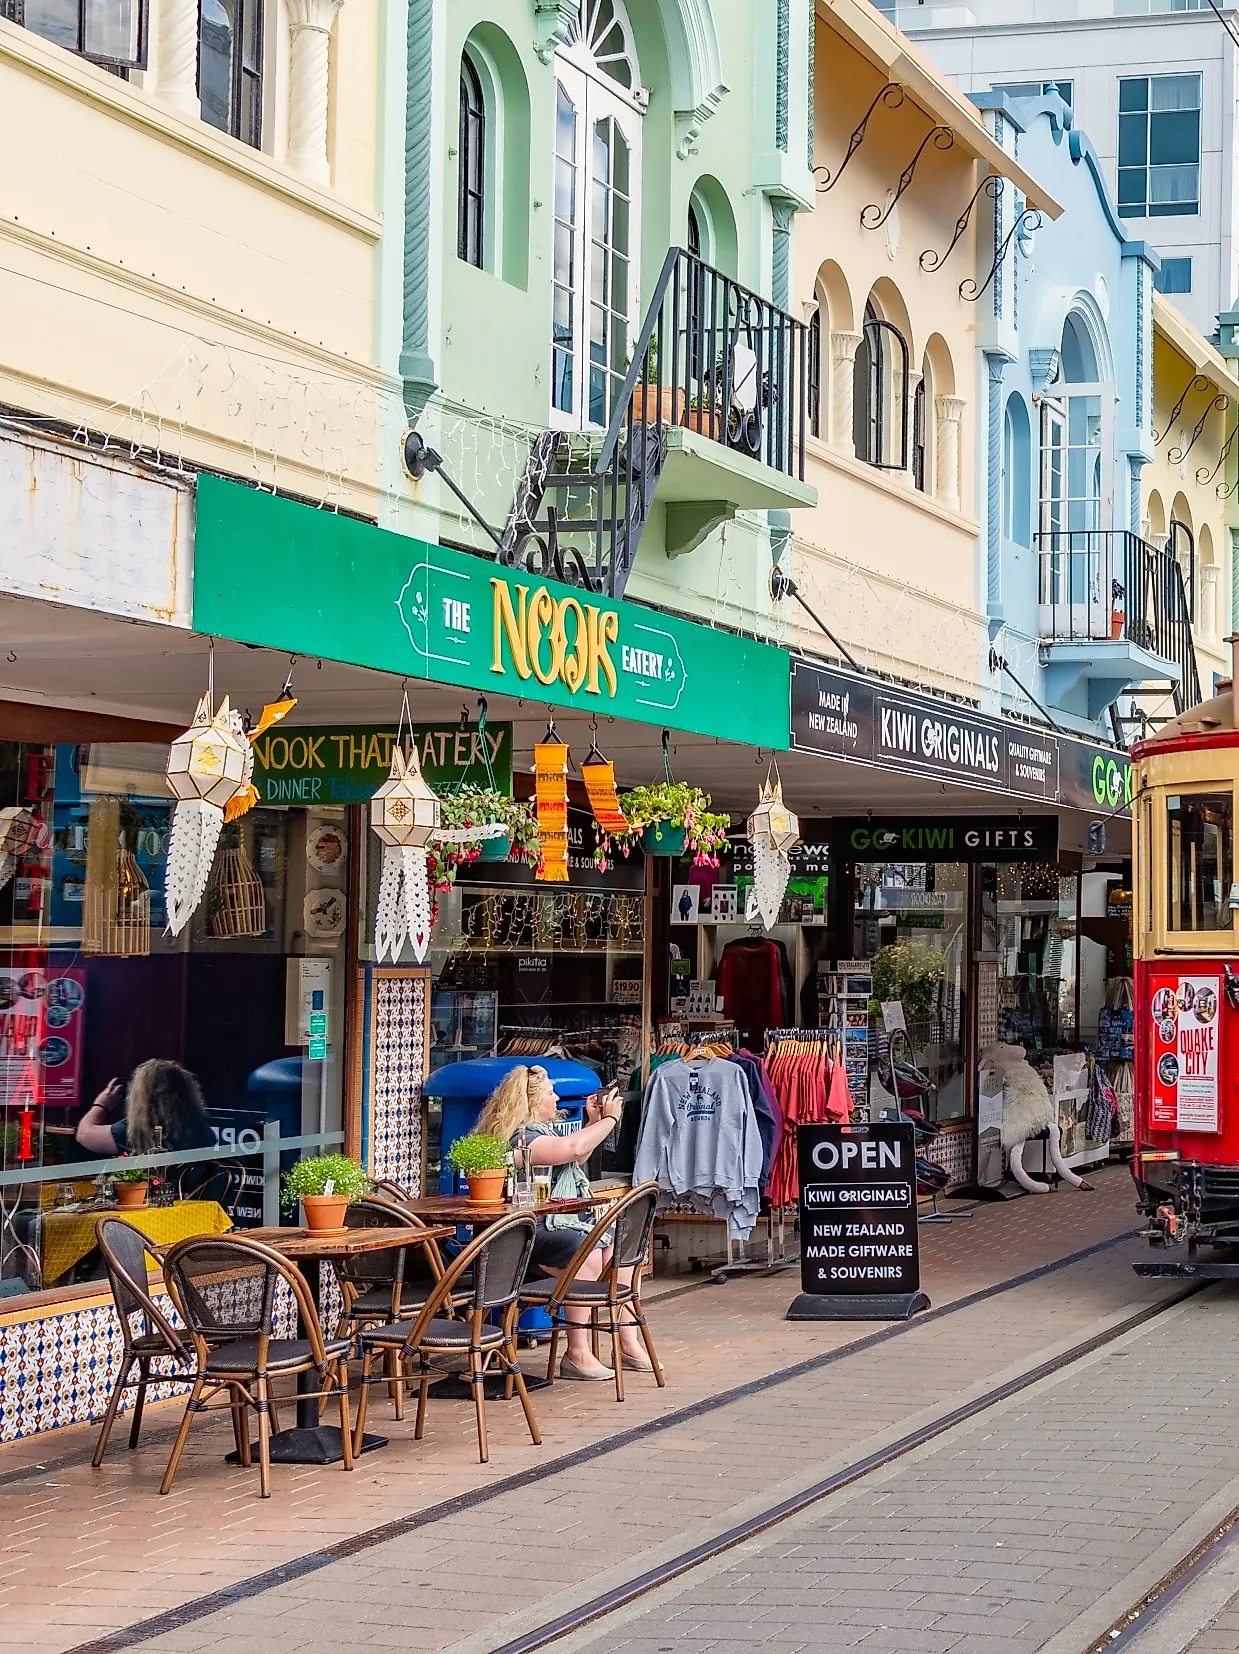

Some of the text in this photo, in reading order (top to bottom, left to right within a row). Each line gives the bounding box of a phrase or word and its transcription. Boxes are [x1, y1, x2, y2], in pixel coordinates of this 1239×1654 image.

[443, 577, 664, 698] THE NOOK EATERY
[819, 690, 850, 713] MADE IN
[809, 711, 858, 738] NEW ZEALAND
[251, 735, 326, 770] NOOK
[330, 731, 398, 769] THAI
[881, 707, 999, 772] KIWI ORIGINALS
[1008, 741, 1052, 765] QUALITY GIFTWARE
[1020, 763, 1046, 782] SOUVENIRS
[266, 777, 322, 801] DINNER
[902, 829, 954, 849] KIWI
[964, 830, 1034, 847] GIFTS
[518, 956, 547, 968] pikitia
[614, 981, 640, 992] $19.90
[1180, 1026, 1214, 1054] QUAKE
[1185, 1051, 1209, 1075] CITY
[811, 1140, 902, 1170] OPEN
[808, 1189, 908, 1203] KIWI ORIGINALS
[813, 1223, 905, 1237] NEW ZEALAND
[806, 1244, 913, 1258] MADE GIFTWARE
[817, 1266, 903, 1279] & SOUVENIRS
